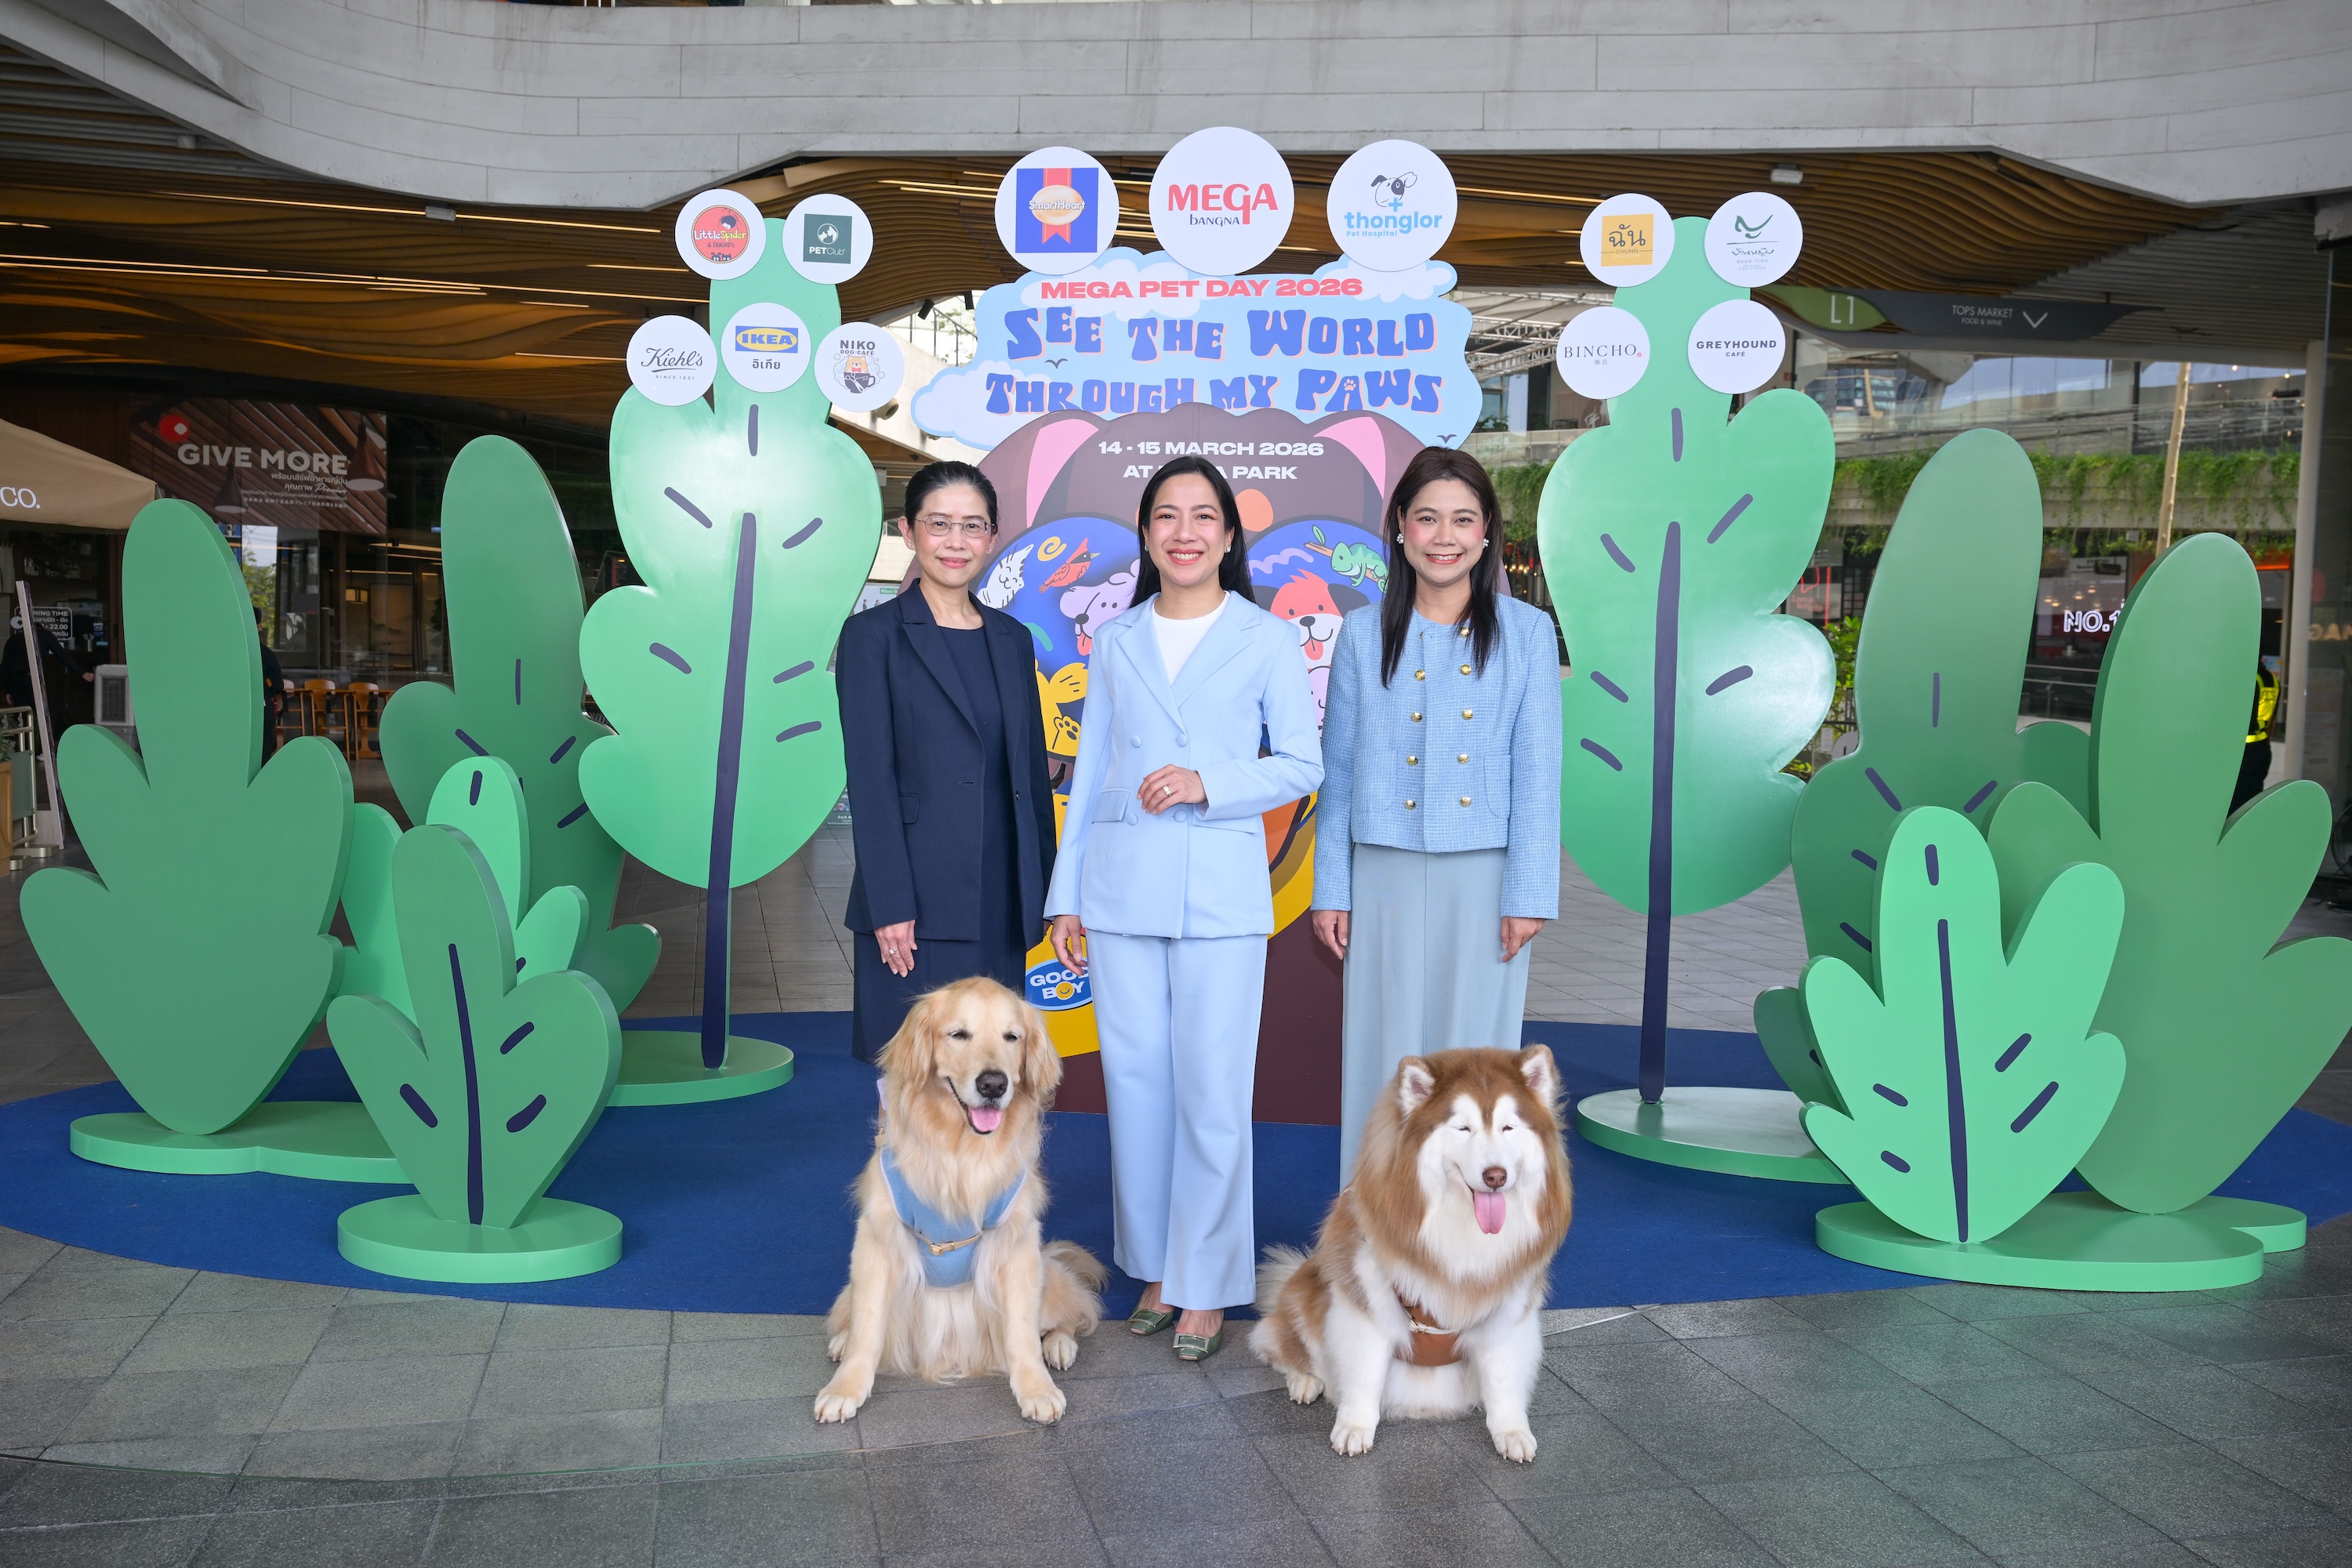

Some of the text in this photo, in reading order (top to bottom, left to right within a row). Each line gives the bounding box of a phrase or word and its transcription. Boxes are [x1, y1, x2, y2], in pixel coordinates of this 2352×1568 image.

[1029, 200, 1086, 210] SmartHeart
[1168, 183, 1278, 225] MEGA
[1344, 211, 1443, 234] thonglor
[1609, 223, 1646, 248] ฉัน
[1041, 278, 1363, 299] MEGA PET DAY 2026
[1830, 294, 1854, 325] L1
[1952, 304, 2013, 318] TOPS MARKET
[742, 333, 793, 346] IKEA
[1004, 307, 1436, 361] SEE THE WORLD
[840, 339, 876, 350] NIKO
[1696, 340, 1777, 349] GREYHOUND
[641, 347, 703, 367] Kiehl's
[752, 358, 781, 369] อิเกีย
[986, 368, 1443, 415] THROUGH MY PAWS
[1098, 441, 1123, 454] 14
[1138, 441, 1161, 455] 15
[1165, 442, 1254, 456] MARCH
[1259, 442, 1324, 456] 2026
[177, 443, 348, 476] GIVE MORE
[1123, 465, 1154, 478] AT
[1232, 466, 1298, 480] PARK
[0, 486, 41, 509] CO.
